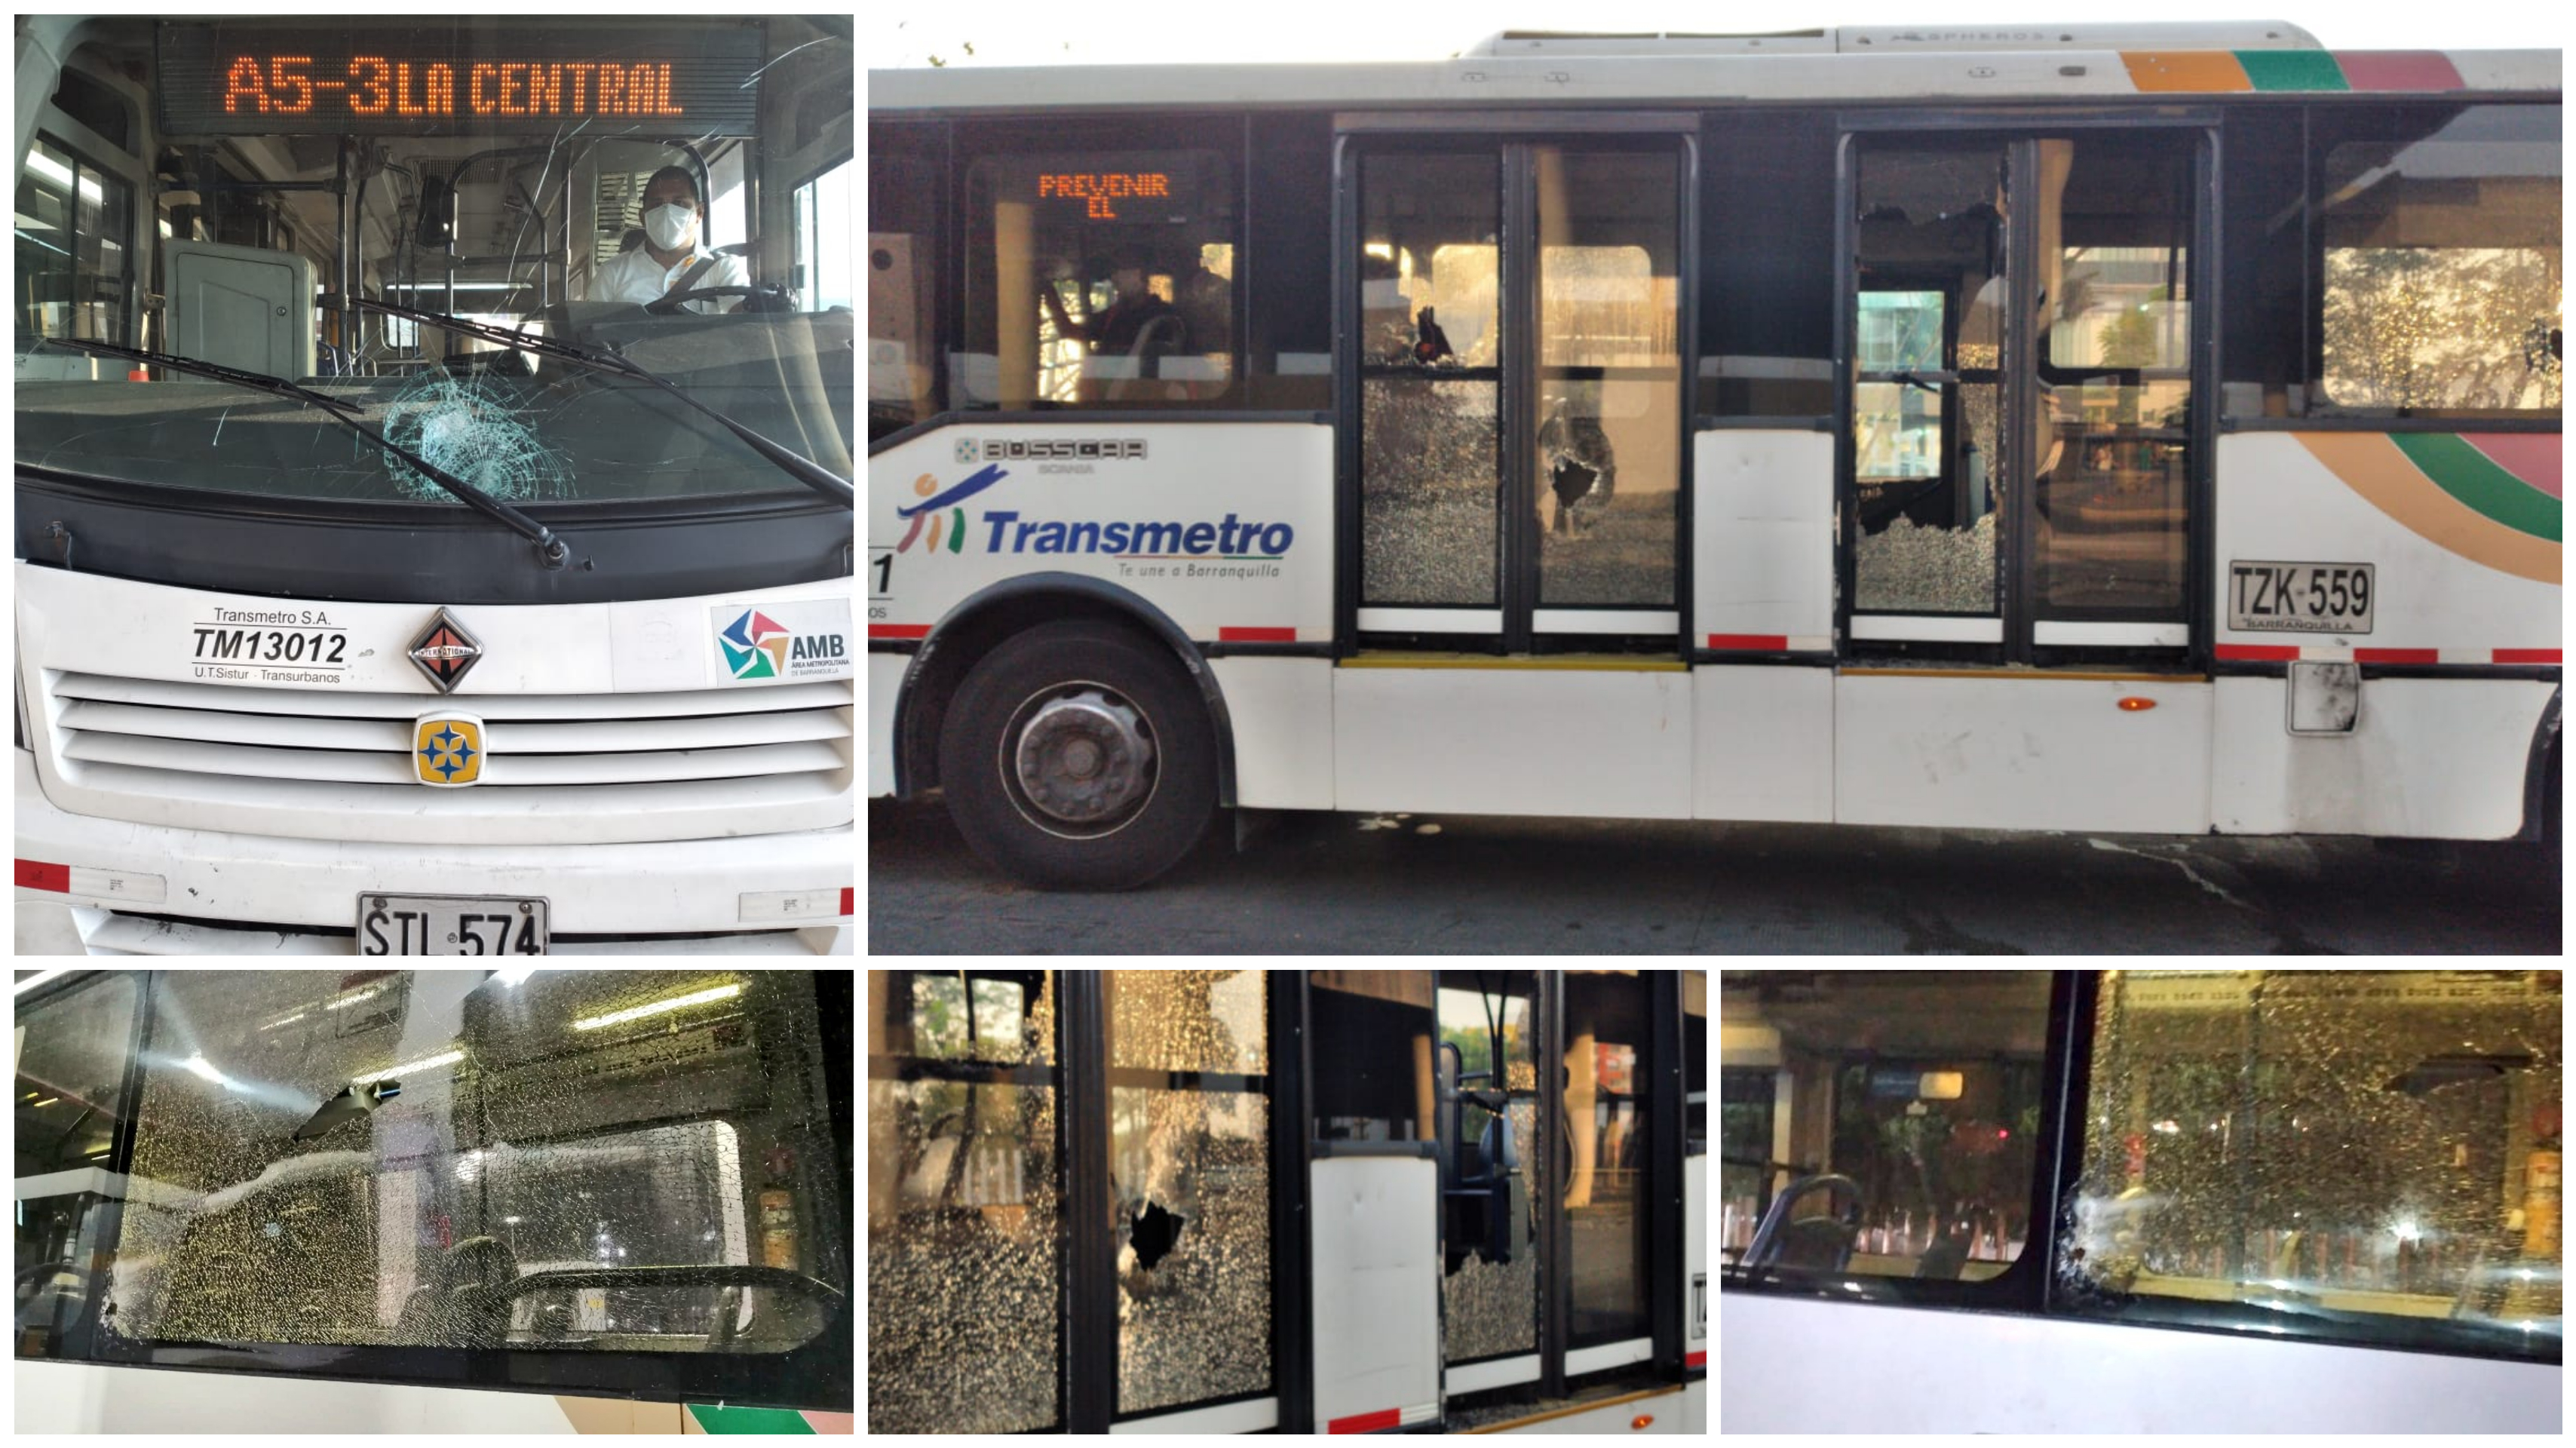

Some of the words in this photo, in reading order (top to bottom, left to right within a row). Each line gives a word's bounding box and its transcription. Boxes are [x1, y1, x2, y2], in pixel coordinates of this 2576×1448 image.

[225, 56, 389, 113] A5-3
[397, 63, 452, 114] LA
[471, 63, 682, 114] CENTRAL
[1040, 174, 1169, 197] PREVENIR
[1089, 196, 1116, 217] EL
[983, 440, 1148, 460] BUSSCAR
[983, 511, 1294, 555] Transmetro
[1119, 563, 1134, 577] Te
[1139, 566, 1165, 577] une
[1172, 567, 1180, 577] a
[1187, 564, 1280, 581] Barranquilla
[2234, 568, 2296, 615] TZK
[2309, 569, 2369, 617] 559
[214, 607, 296, 624] Transmetro
[302, 611, 331, 625] S.A.
[2245, 619, 2352, 630] BARRANQUILLA
[194, 628, 347, 663] TM13012
[792, 634, 845, 660] AMB
[807, 658, 850, 667] METROPOLITANA
[261, 670, 340, 683] Transurbanos
[365, 911, 445, 956] STL
[459, 913, 541, 956] 574
